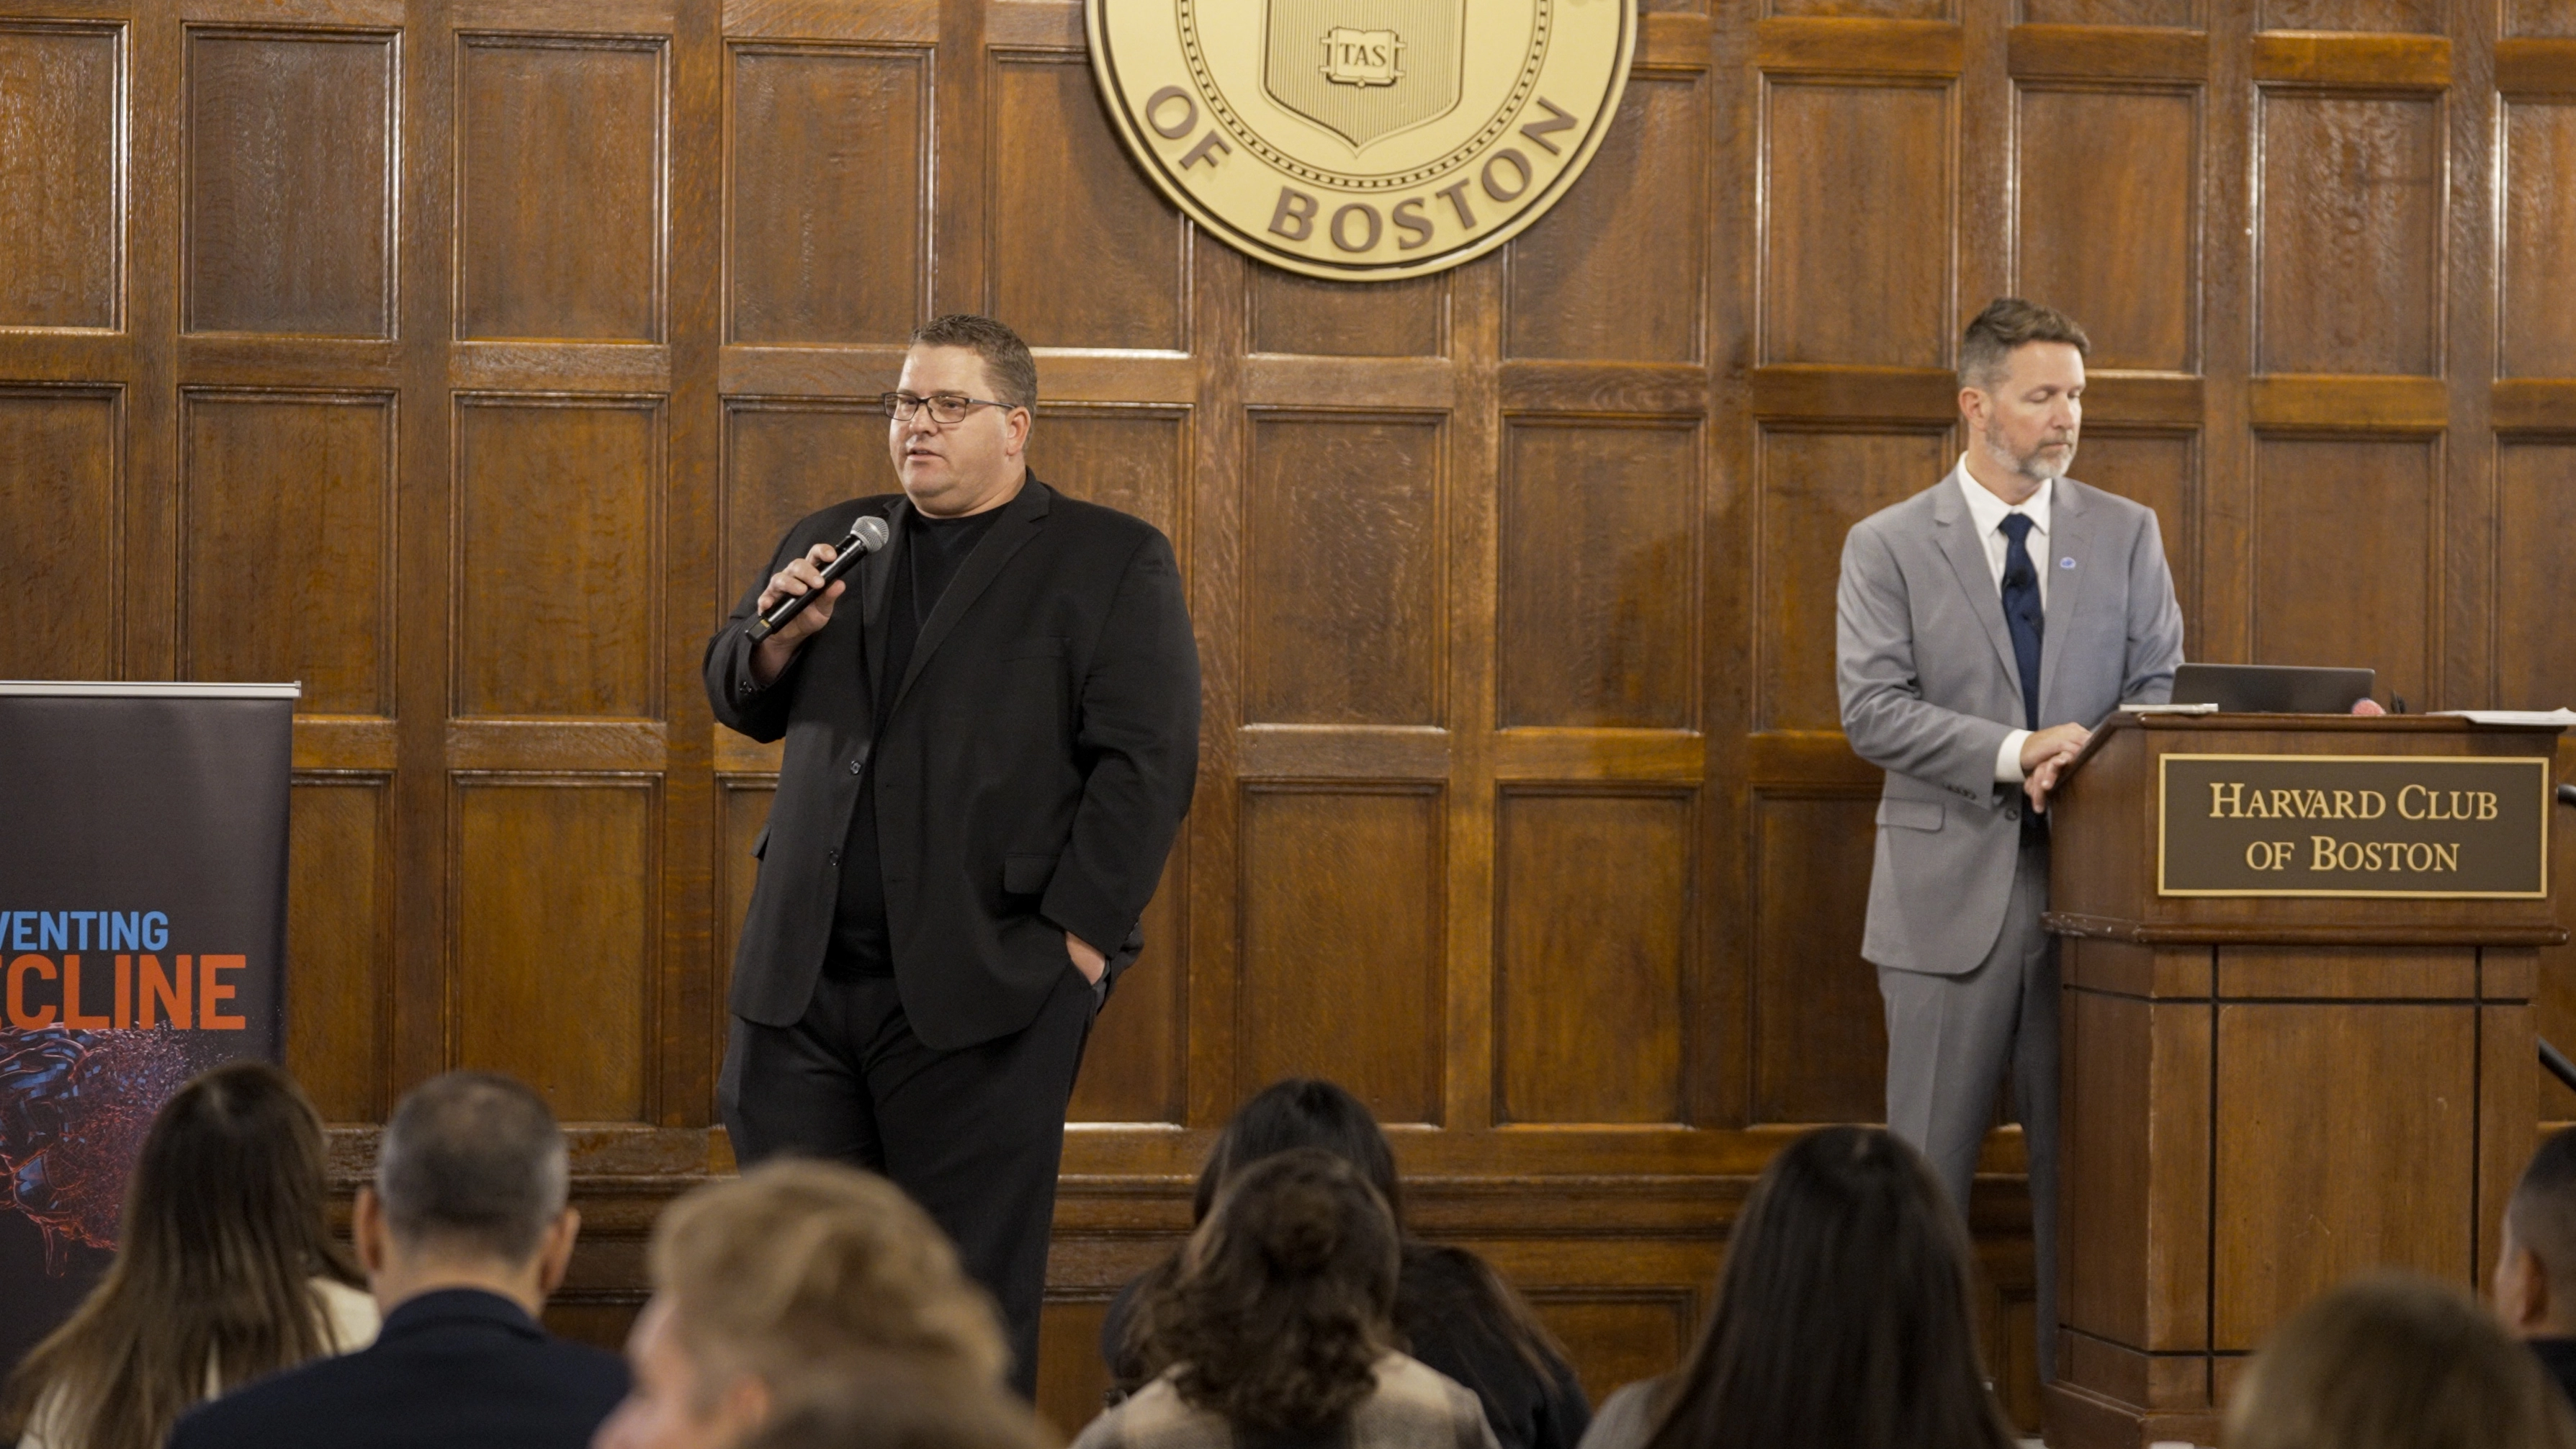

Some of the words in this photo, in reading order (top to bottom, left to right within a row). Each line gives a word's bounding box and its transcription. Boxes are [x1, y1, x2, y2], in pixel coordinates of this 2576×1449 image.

[1339, 42, 1387, 68] TAS
[1145, 85, 1232, 171] OF
[1267, 97, 1579, 253] BOSTON
[2209, 783, 2386, 819] HARVARD
[2398, 784, 2498, 820] CLUB
[2245, 841, 2295, 871] OF
[2310, 835, 2460, 872] BOSTON
[0, 954, 246, 1030] CLINE
